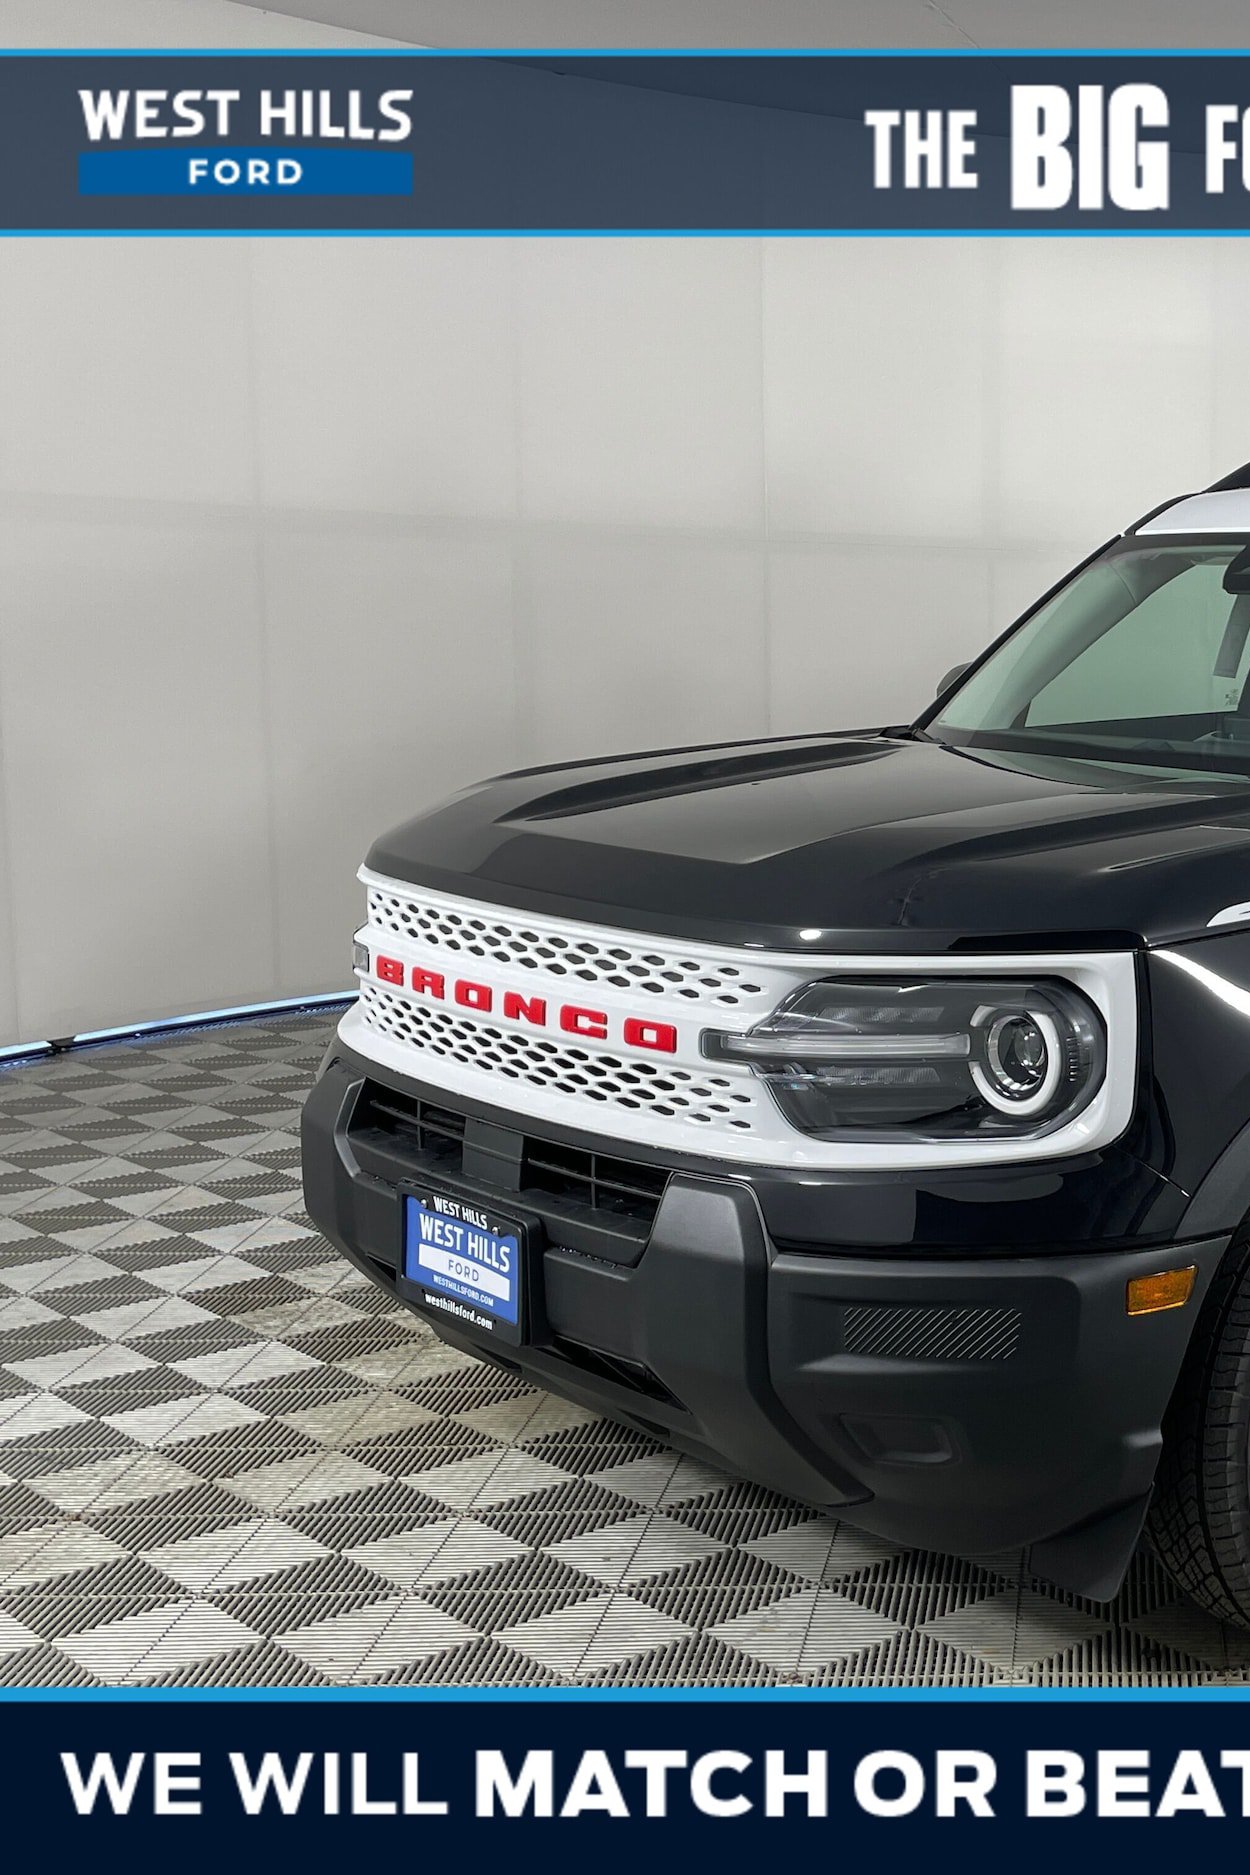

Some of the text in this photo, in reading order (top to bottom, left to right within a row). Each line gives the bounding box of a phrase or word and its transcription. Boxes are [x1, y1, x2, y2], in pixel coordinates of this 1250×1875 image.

[376, 956, 678, 1054] BRONCO
[433, 1195, 488, 1230] WEST HILLS
[419, 1212, 511, 1273] WEST HILLS
[448, 1259, 480, 1282] FORD
[433, 1274, 494, 1307] WESTHILLSFORD.COM
[424, 1293, 493, 1330] westhillsford.com
